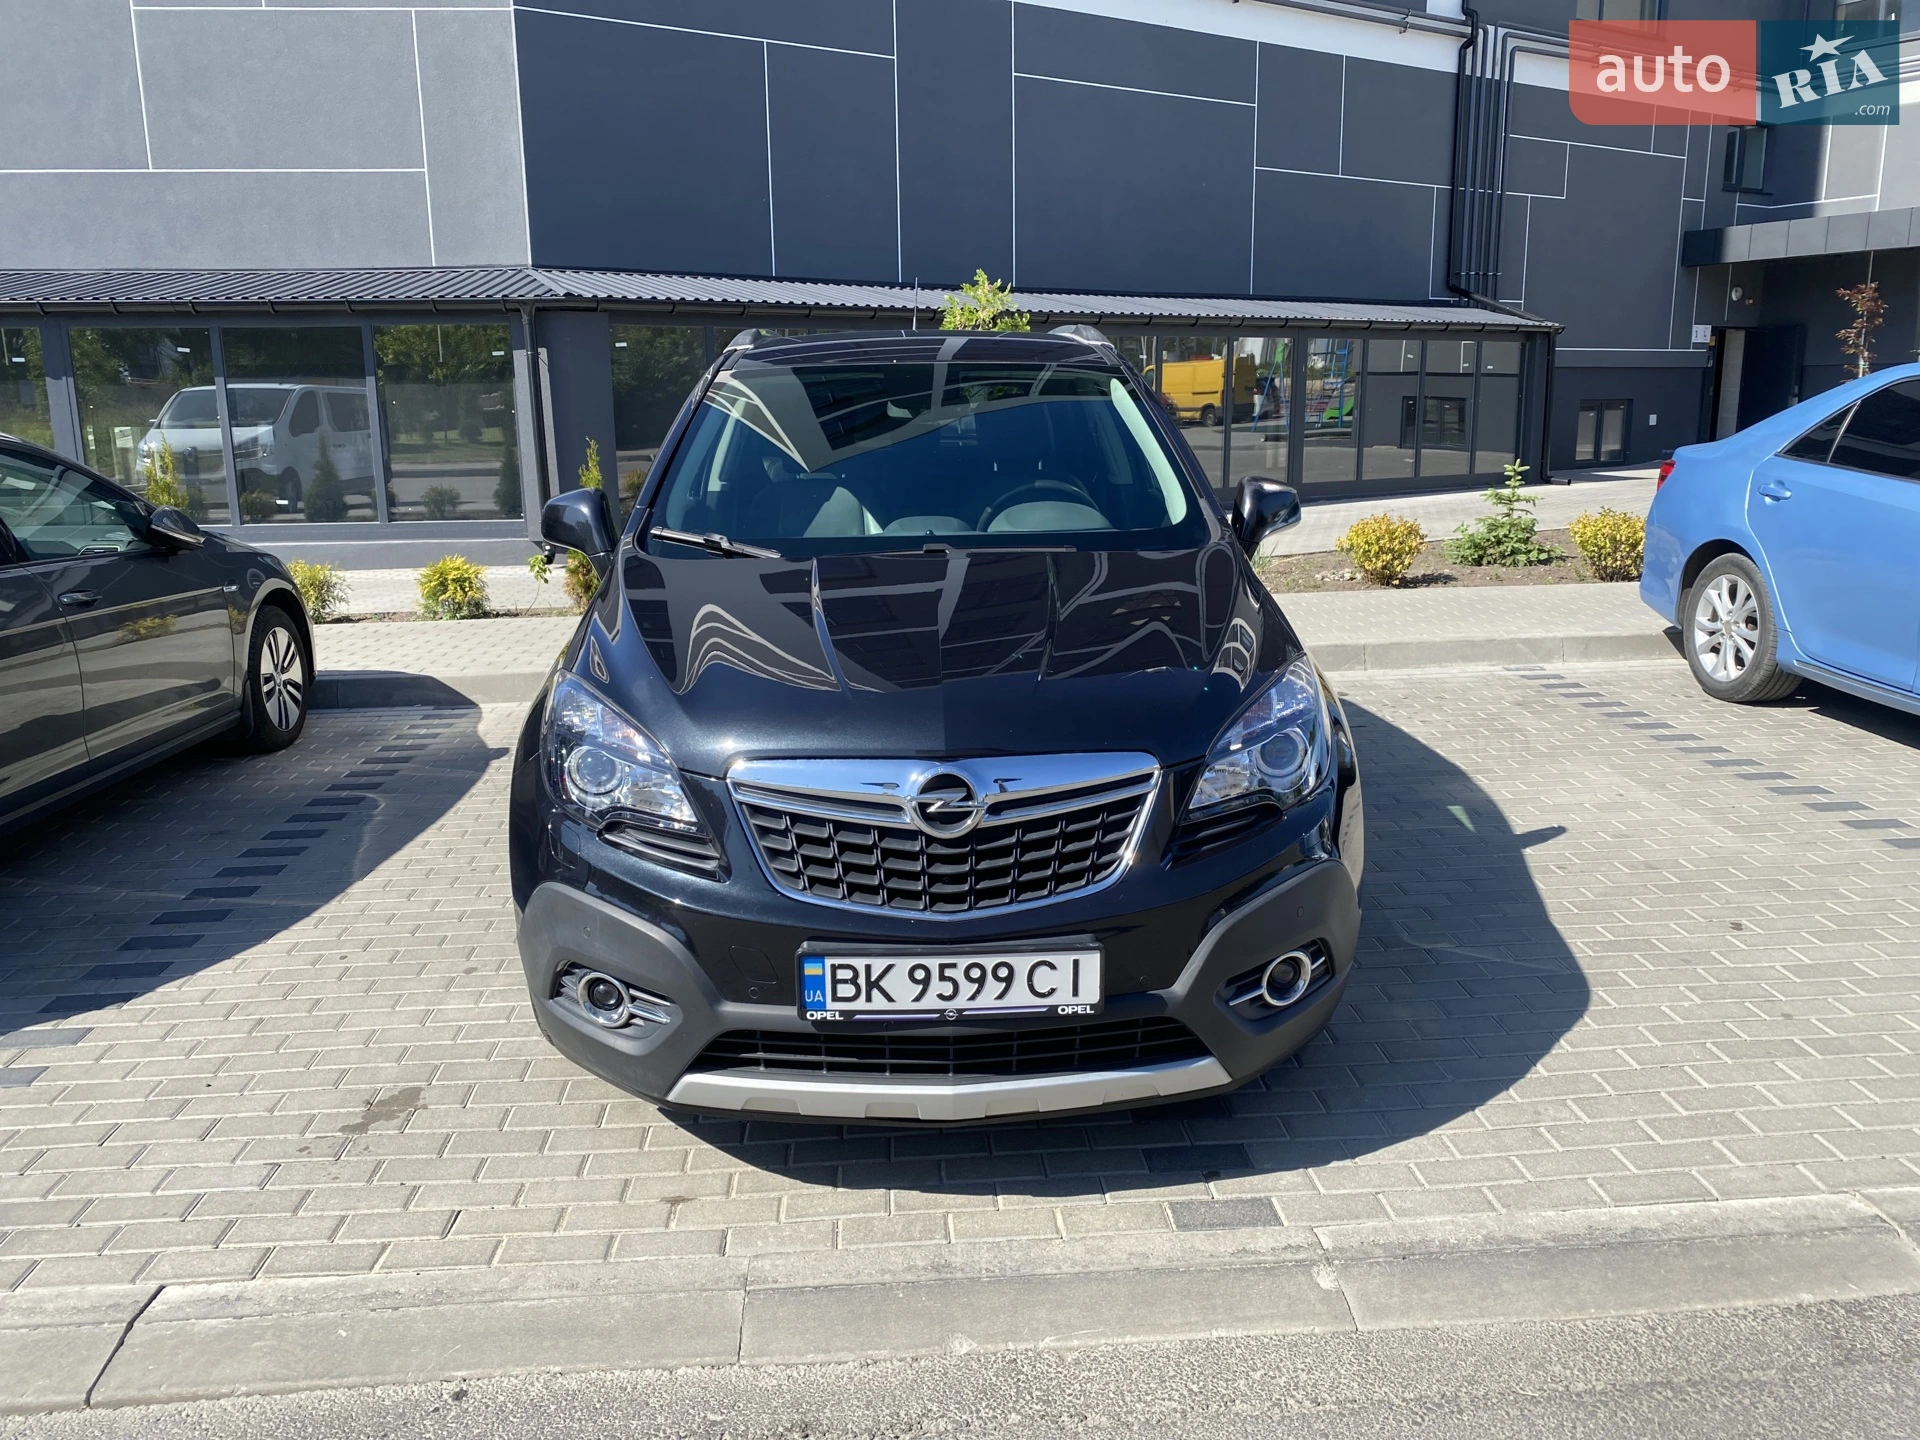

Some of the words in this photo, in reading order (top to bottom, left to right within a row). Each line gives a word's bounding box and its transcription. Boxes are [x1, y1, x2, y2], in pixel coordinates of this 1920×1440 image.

[829, 962, 896, 1003] BK
[907, 959, 1015, 1002] 9599
[1026, 959, 1081, 998] CI
[804, 990, 824, 1003] UA
[806, 1010, 844, 1021] OPEL
[1057, 1004, 1095, 1015] OPEL
